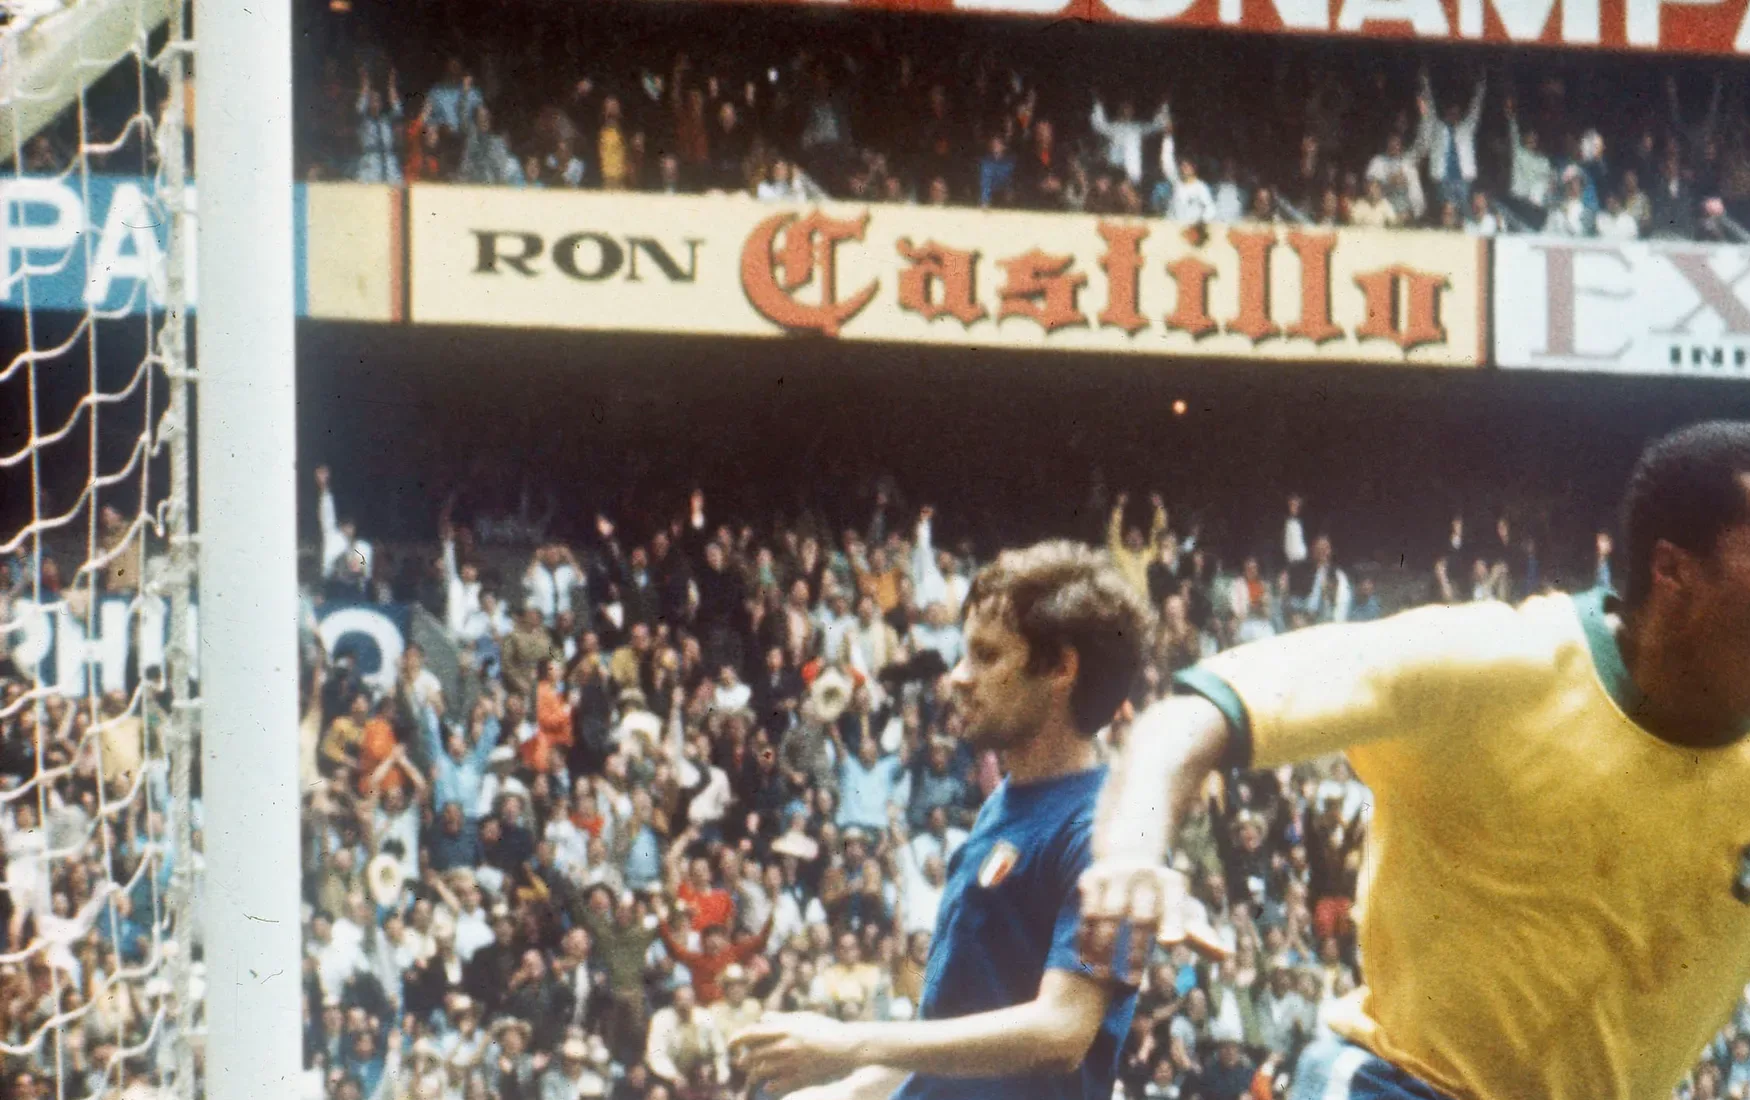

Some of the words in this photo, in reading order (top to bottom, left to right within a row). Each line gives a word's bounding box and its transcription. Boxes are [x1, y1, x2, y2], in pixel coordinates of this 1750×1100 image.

[0, 177, 197, 304] PA
[470, 229, 705, 283] RON
[740, 208, 1450, 352] Castillo
